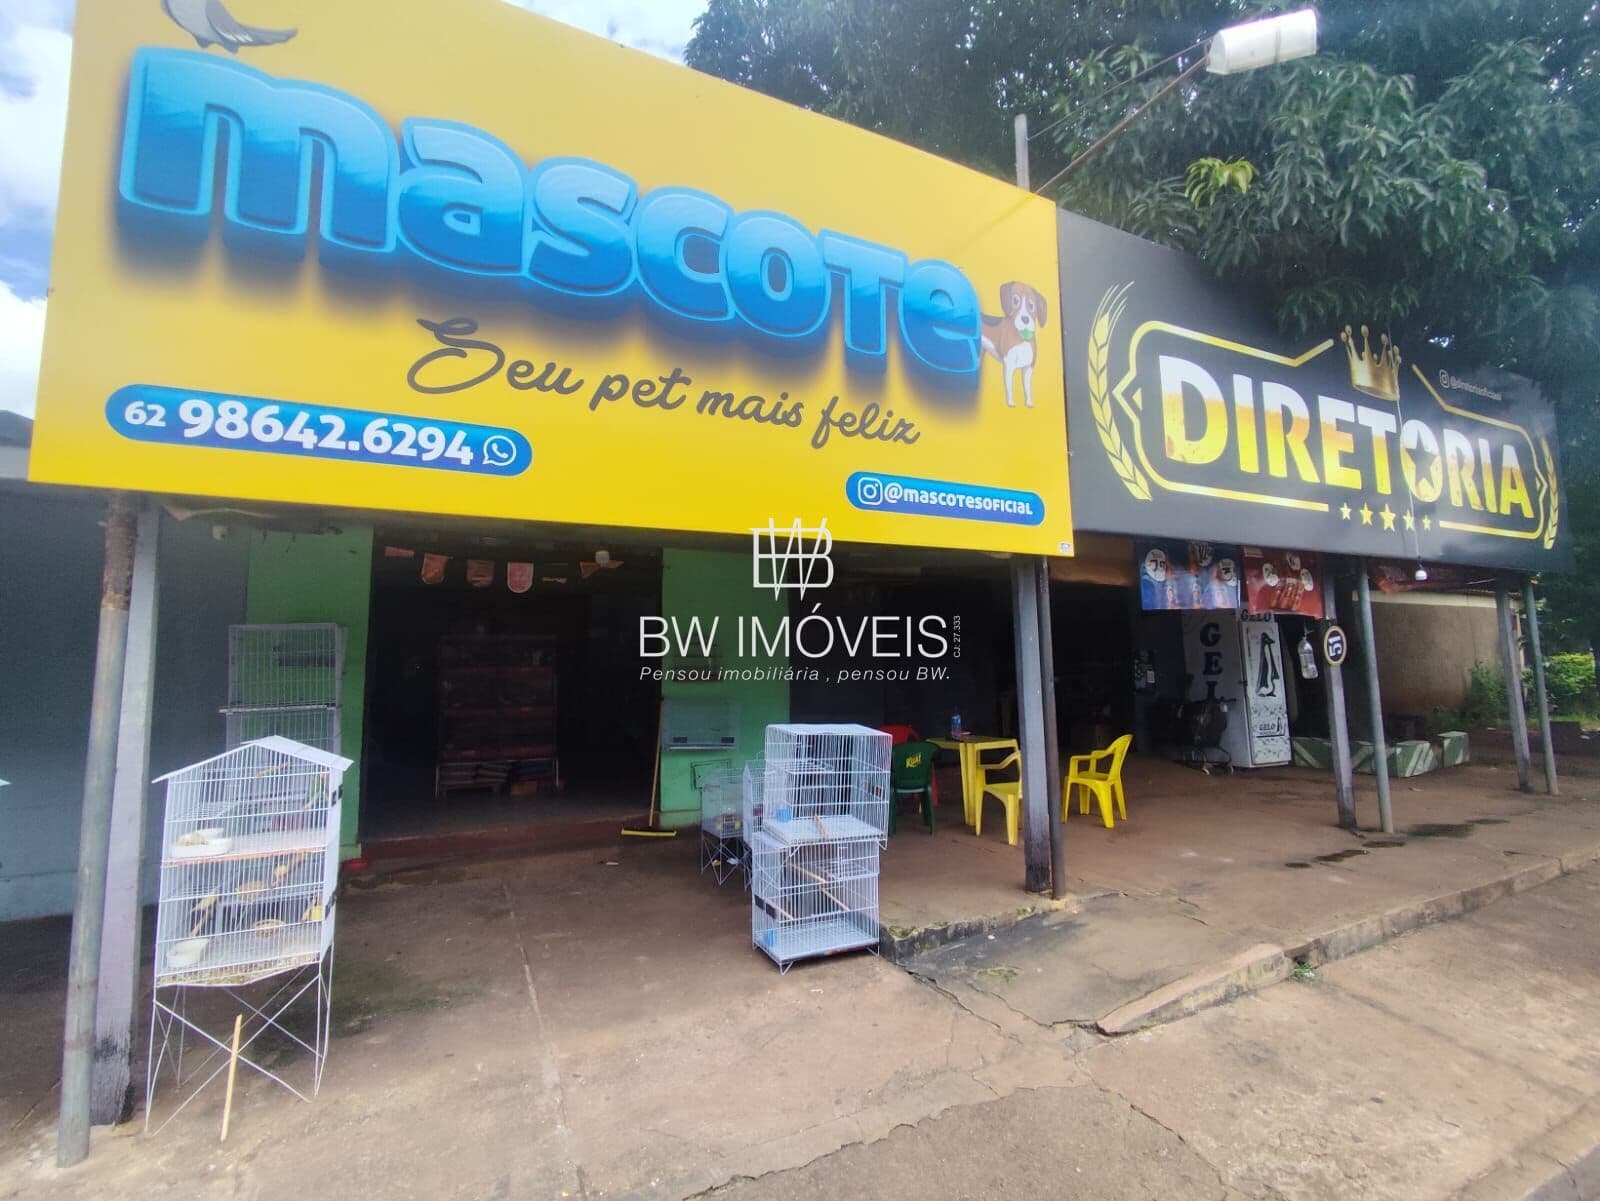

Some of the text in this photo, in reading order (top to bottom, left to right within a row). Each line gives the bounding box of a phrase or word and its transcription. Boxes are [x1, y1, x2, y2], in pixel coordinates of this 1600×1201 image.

[124, 400, 474, 466] 62 98642.6294
[406, 317, 922, 450] Seu pet mais feliz
[1157, 354, 1536, 519] DIRETORIA
[1328, 635, 1343, 657] 51
